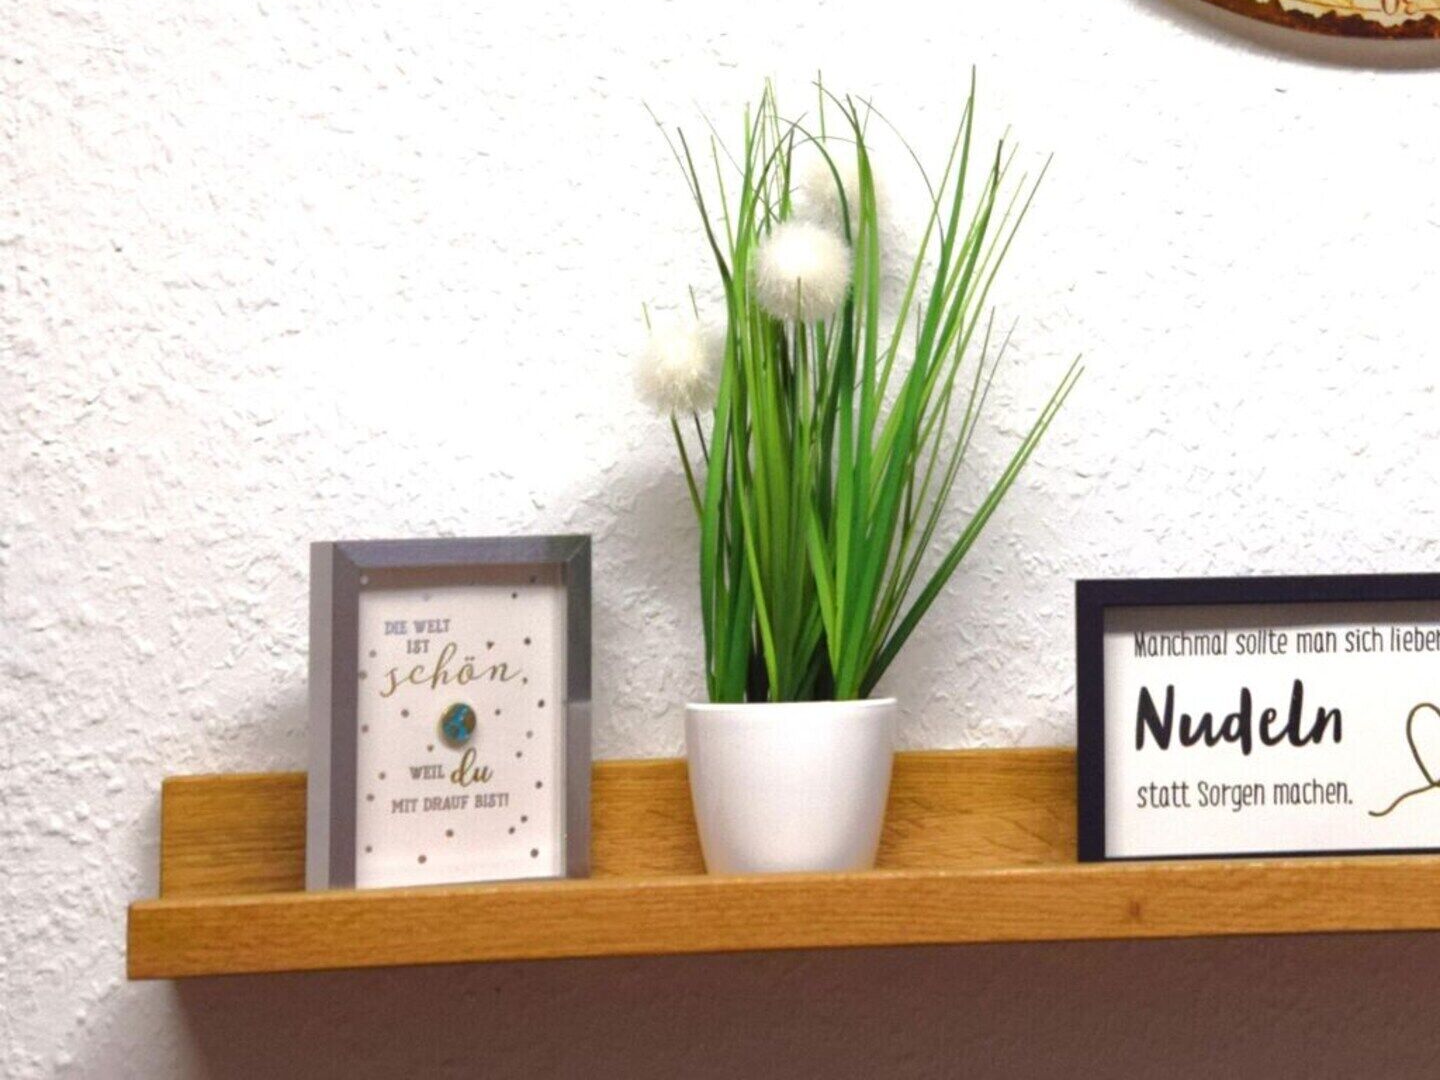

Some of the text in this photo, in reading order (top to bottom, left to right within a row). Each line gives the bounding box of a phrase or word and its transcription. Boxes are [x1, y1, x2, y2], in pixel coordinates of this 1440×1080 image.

[384, 618, 451, 636] DIE WELT
[1133, 629, 1228, 658] Manchmal
[1235, 628, 1288, 655] sollte
[1296, 629, 1338, 653] man
[1345, 626, 1385, 653] sich
[406, 639, 430, 655] IST
[1135, 678, 1343, 757] Nudeln
[409, 747, 494, 788] WEIL du
[391, 792, 510, 814] MIT DRAUF BIST!
[1137, 778, 1354, 812] statt Sorgen machen.
